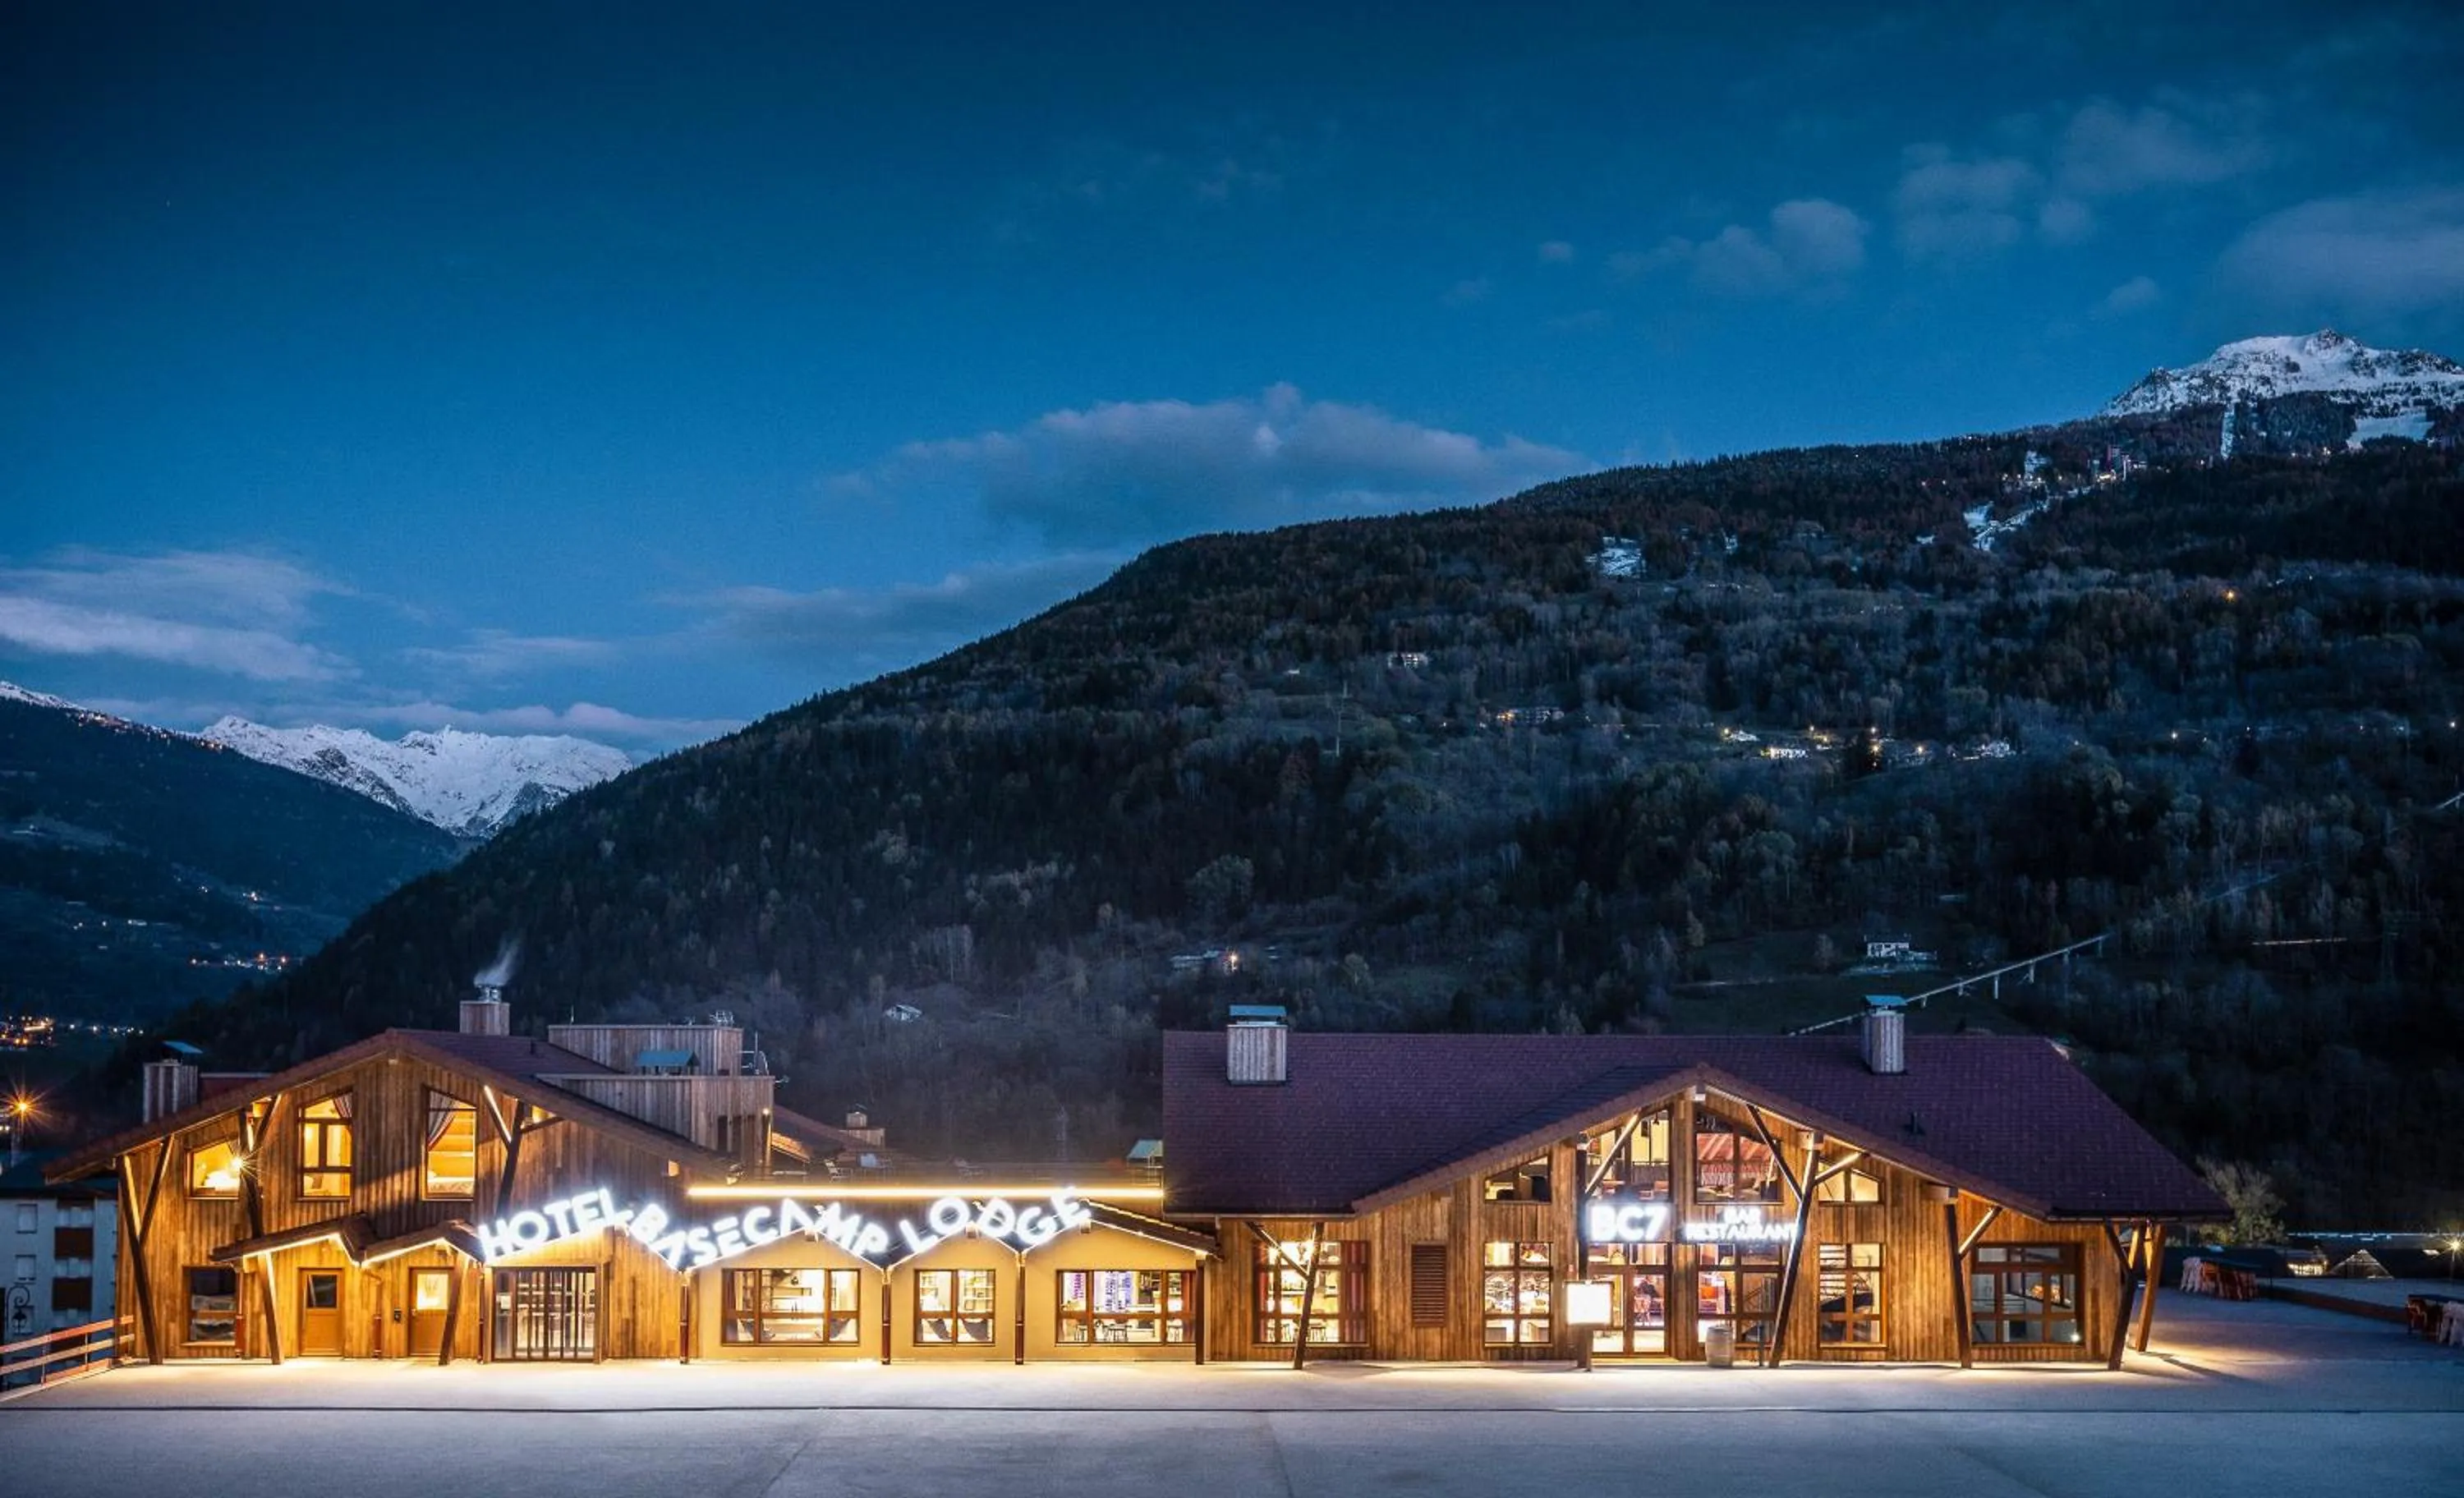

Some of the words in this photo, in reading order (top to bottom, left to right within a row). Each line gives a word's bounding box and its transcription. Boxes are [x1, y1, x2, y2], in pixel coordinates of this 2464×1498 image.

[478, 1188, 633, 1262] HOTEL
[900, 1188, 1091, 1252] LODGE
[1592, 1205, 1667, 1241] BC7
[1724, 1206, 1762, 1224] BAR
